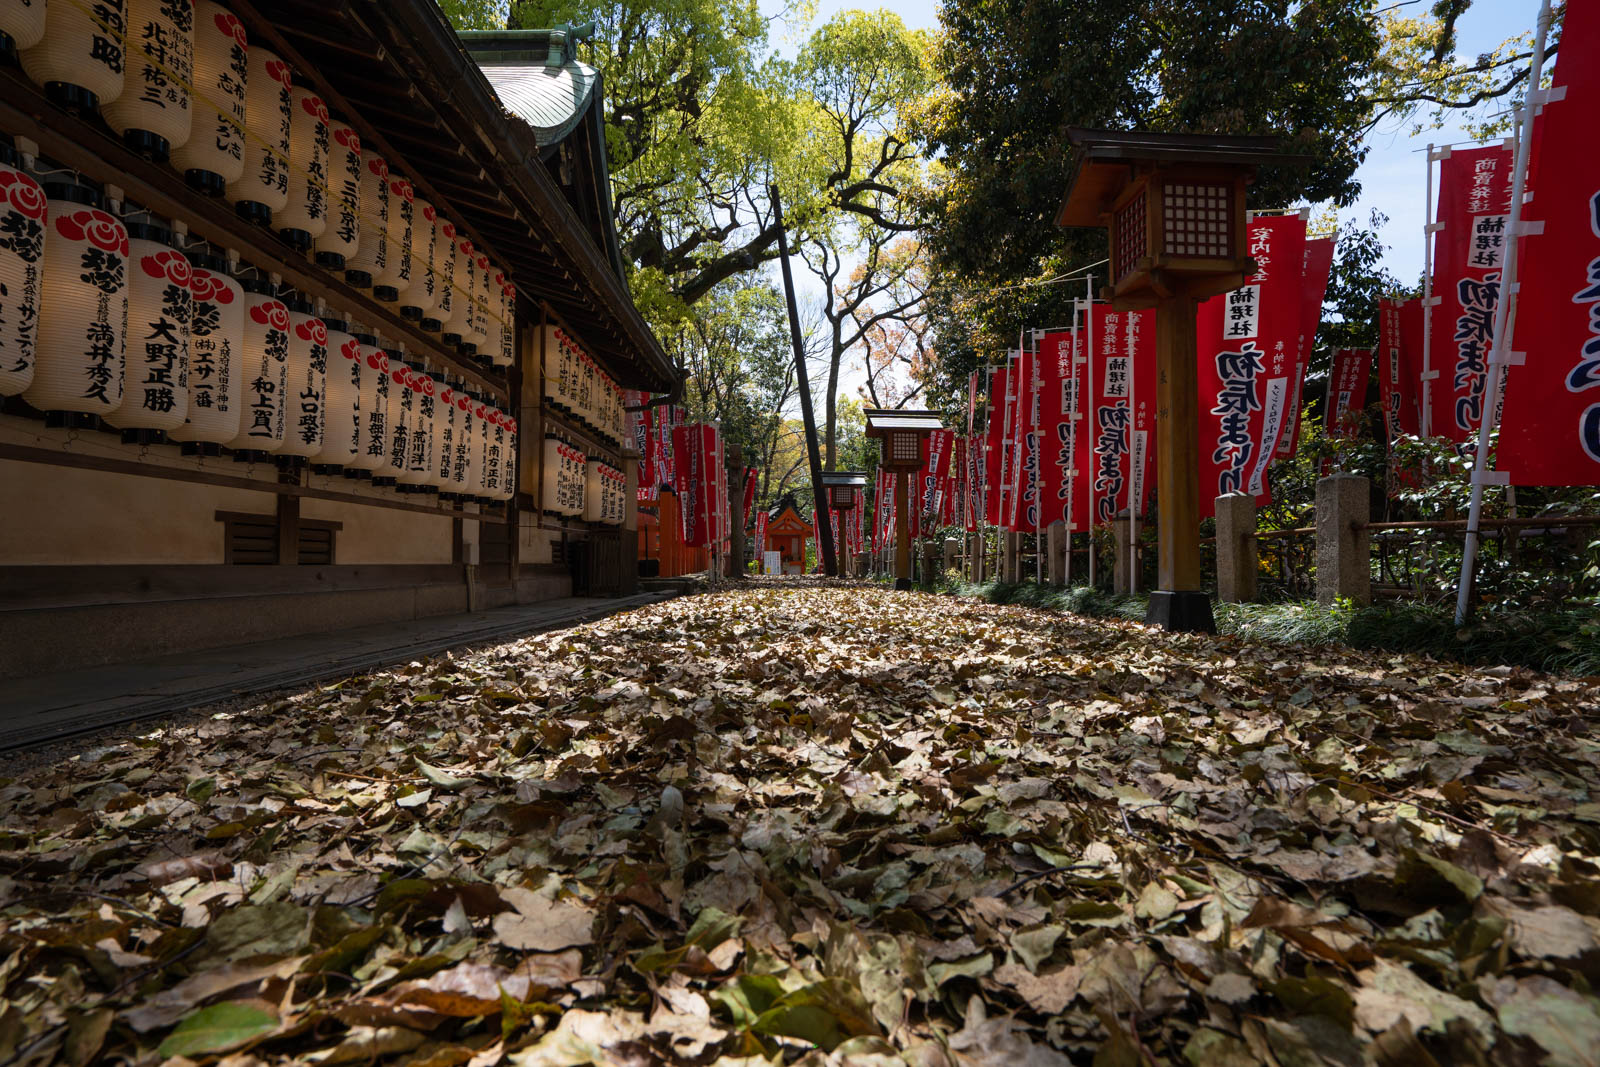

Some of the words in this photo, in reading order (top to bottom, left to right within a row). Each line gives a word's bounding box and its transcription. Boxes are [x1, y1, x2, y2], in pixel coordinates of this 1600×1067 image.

[142, 317, 179, 412] 大野正勝
[248, 376, 275, 438] 和上賀一
